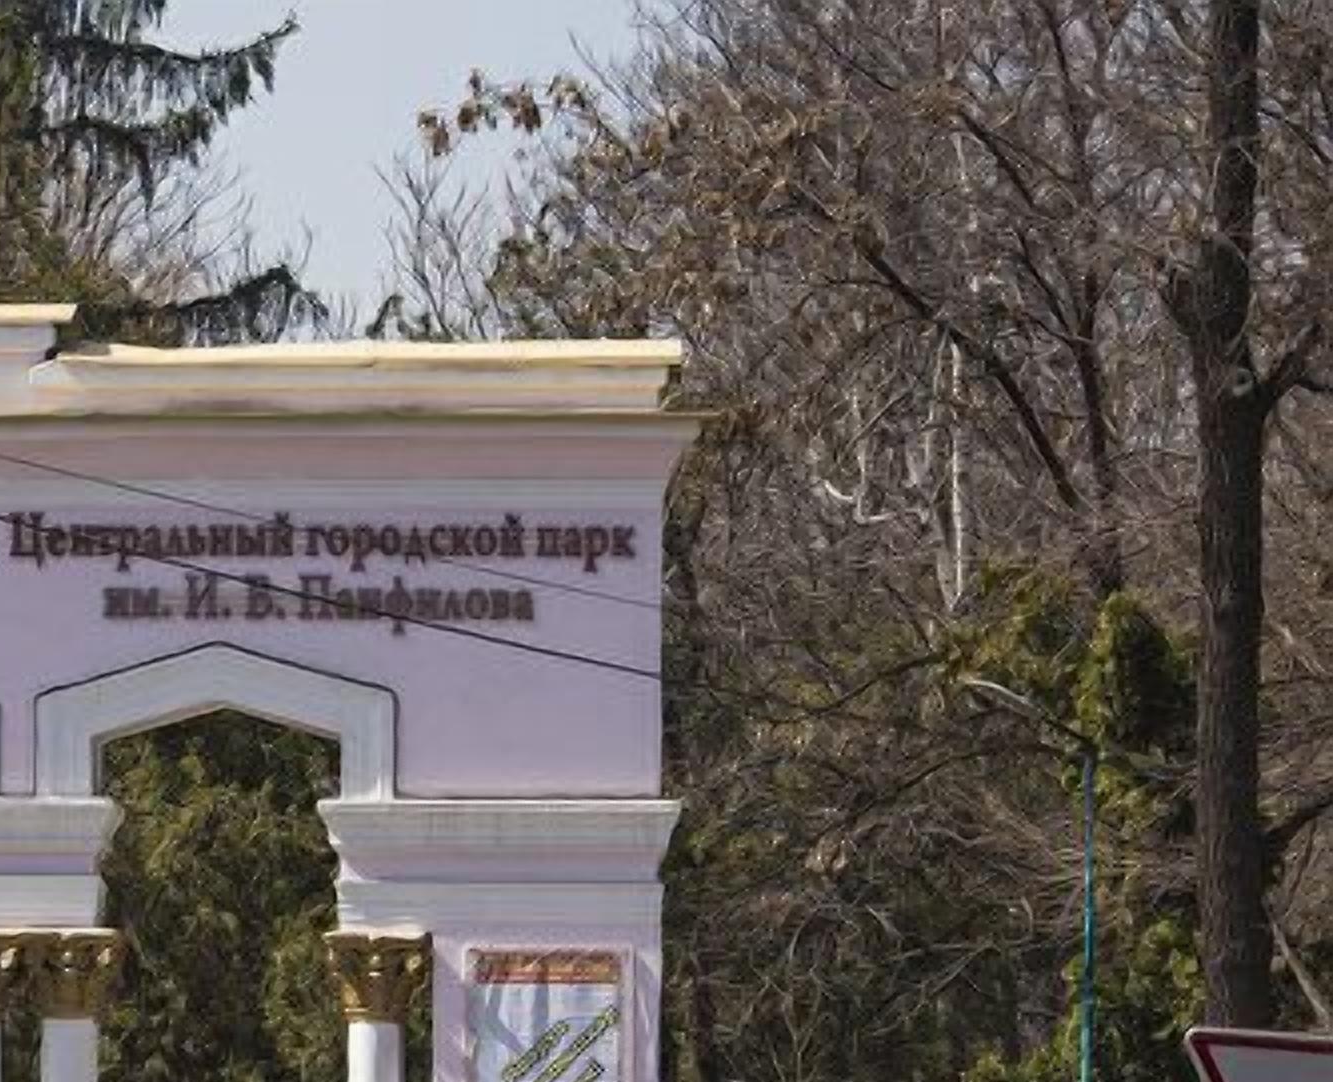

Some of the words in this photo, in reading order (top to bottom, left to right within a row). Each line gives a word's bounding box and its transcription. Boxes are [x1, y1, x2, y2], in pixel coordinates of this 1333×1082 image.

[9, 511, 295, 572] Центральный
[305, 511, 525, 572] городской
[535, 524, 636, 573] парк
[103, 586, 172, 620] им.
[184, 574, 231, 620] И.
[244, 574, 286, 620] В.
[298, 573, 537, 634] Панфилова
